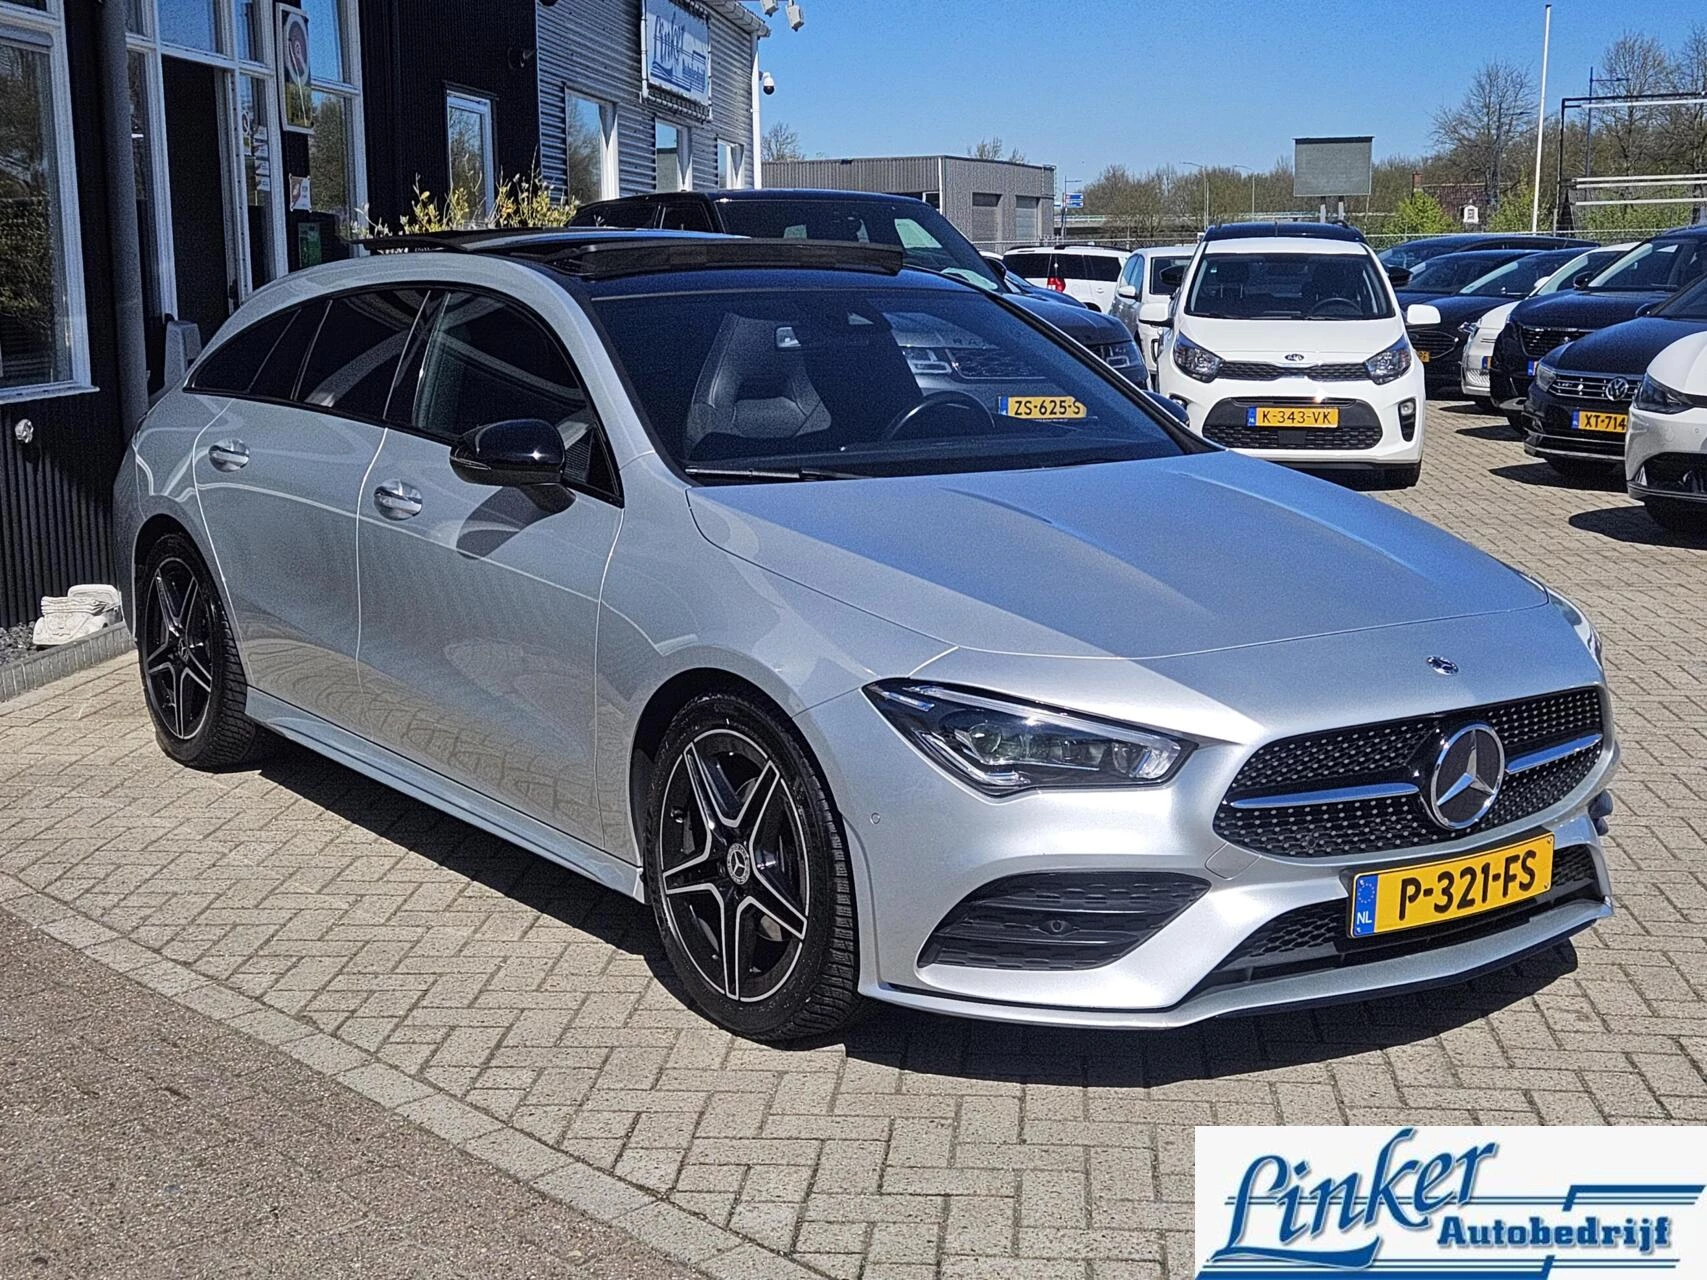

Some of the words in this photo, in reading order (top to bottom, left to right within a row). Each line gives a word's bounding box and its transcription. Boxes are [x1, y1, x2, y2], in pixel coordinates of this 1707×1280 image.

[1014, 400, 1081, 416] ZS-625-S
[1262, 410, 1332, 424] K-343-VK
[1356, 911, 1372, 924] NL
[1399, 850, 1537, 920] P-321-FS
